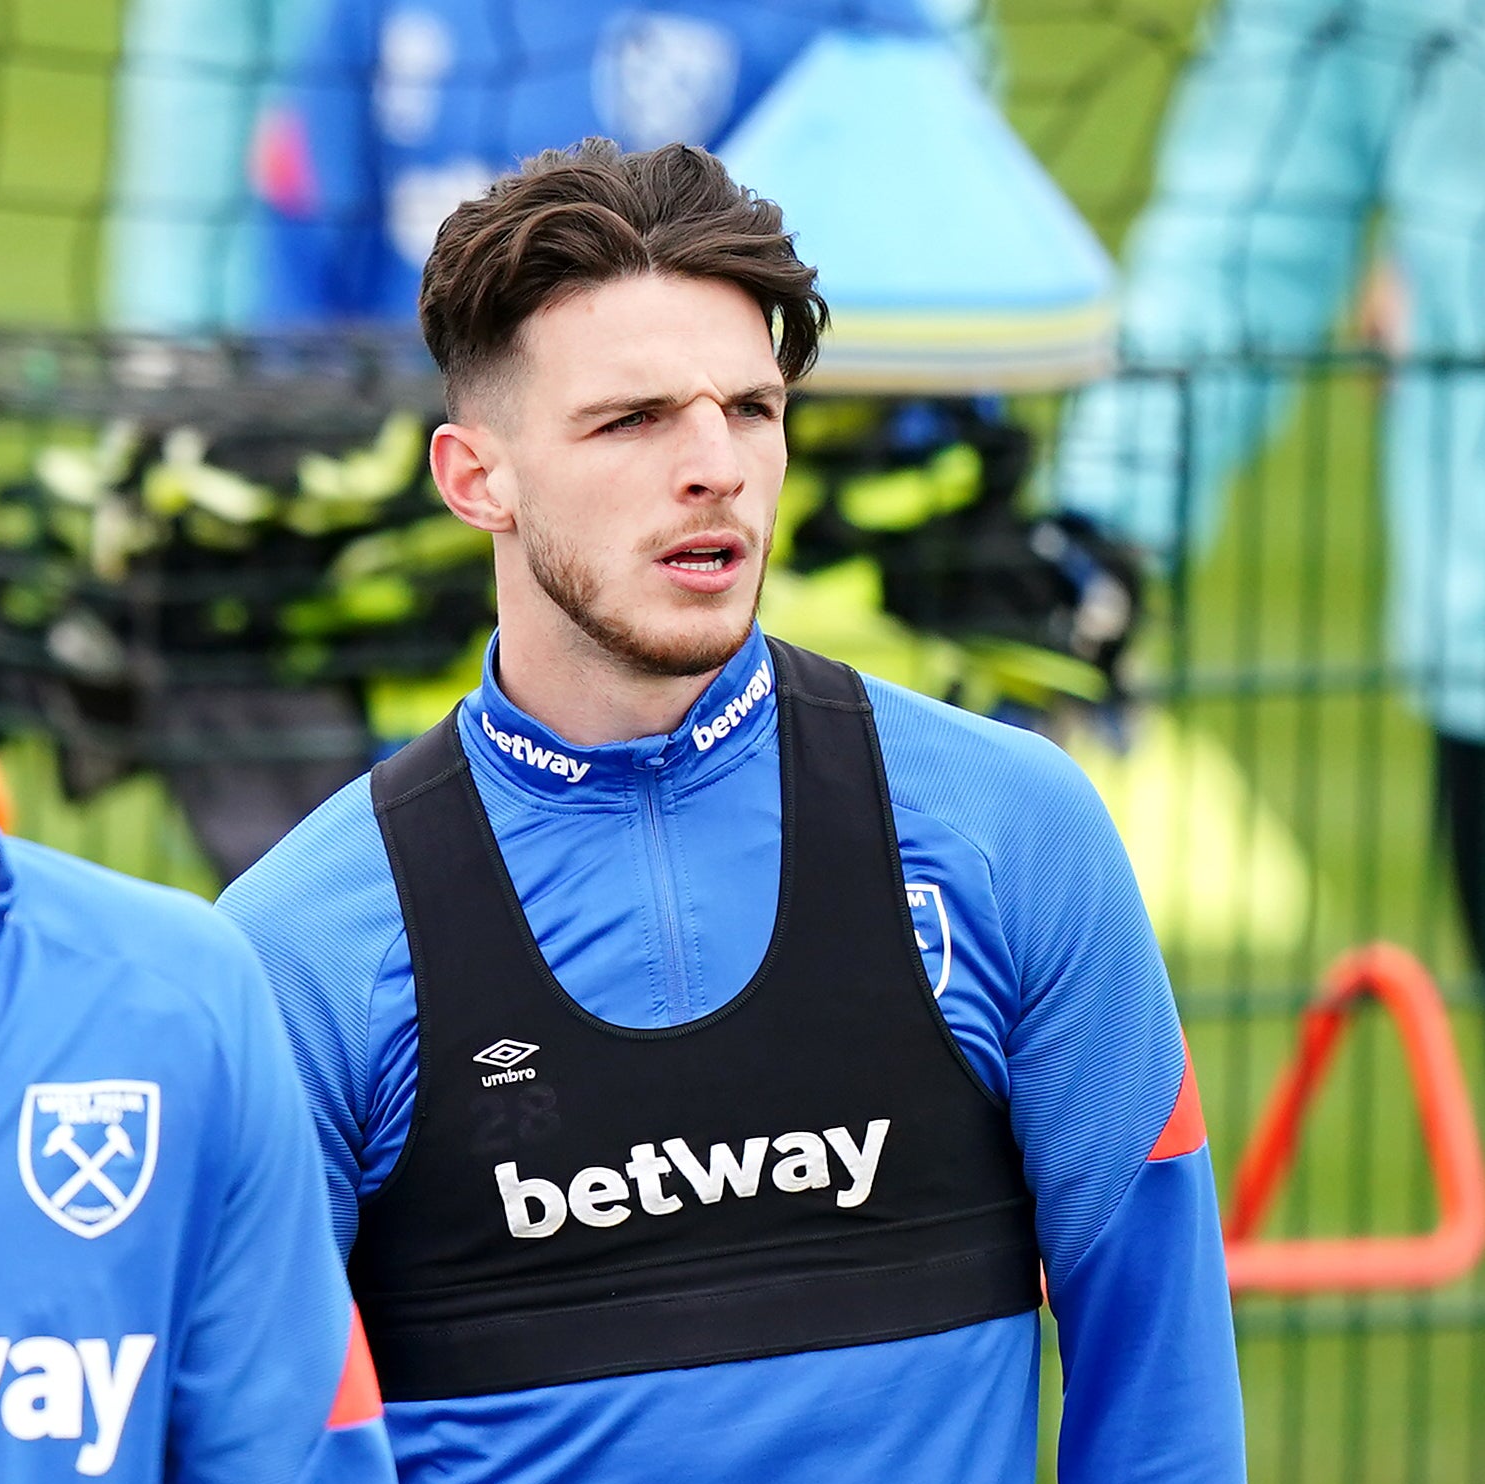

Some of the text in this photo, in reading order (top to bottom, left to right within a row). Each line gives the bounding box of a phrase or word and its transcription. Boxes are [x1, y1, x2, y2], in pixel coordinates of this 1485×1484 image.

[693, 660, 773, 751] betway
[481, 712, 591, 783] betway
[481, 1067, 536, 1087] umbro
[494, 1118, 891, 1239] betway
